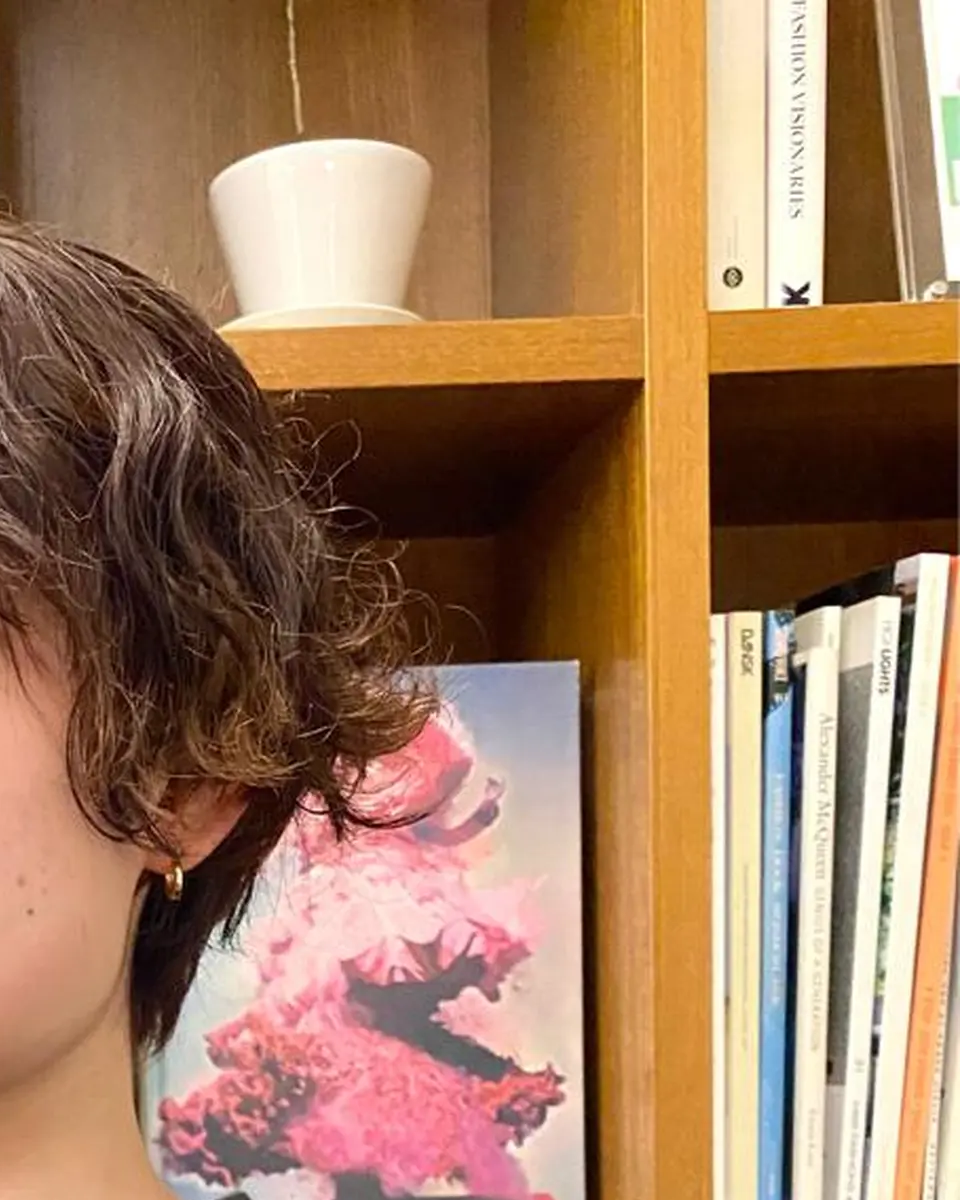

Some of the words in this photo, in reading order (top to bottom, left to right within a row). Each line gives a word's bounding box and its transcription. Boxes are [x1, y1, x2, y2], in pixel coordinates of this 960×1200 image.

[791, 0, 807, 86] FASHION
[788, 91, 806, 220] VISIONARIES
[817, 712, 835, 795] Alexander
[813, 799, 832, 880] McQueen
